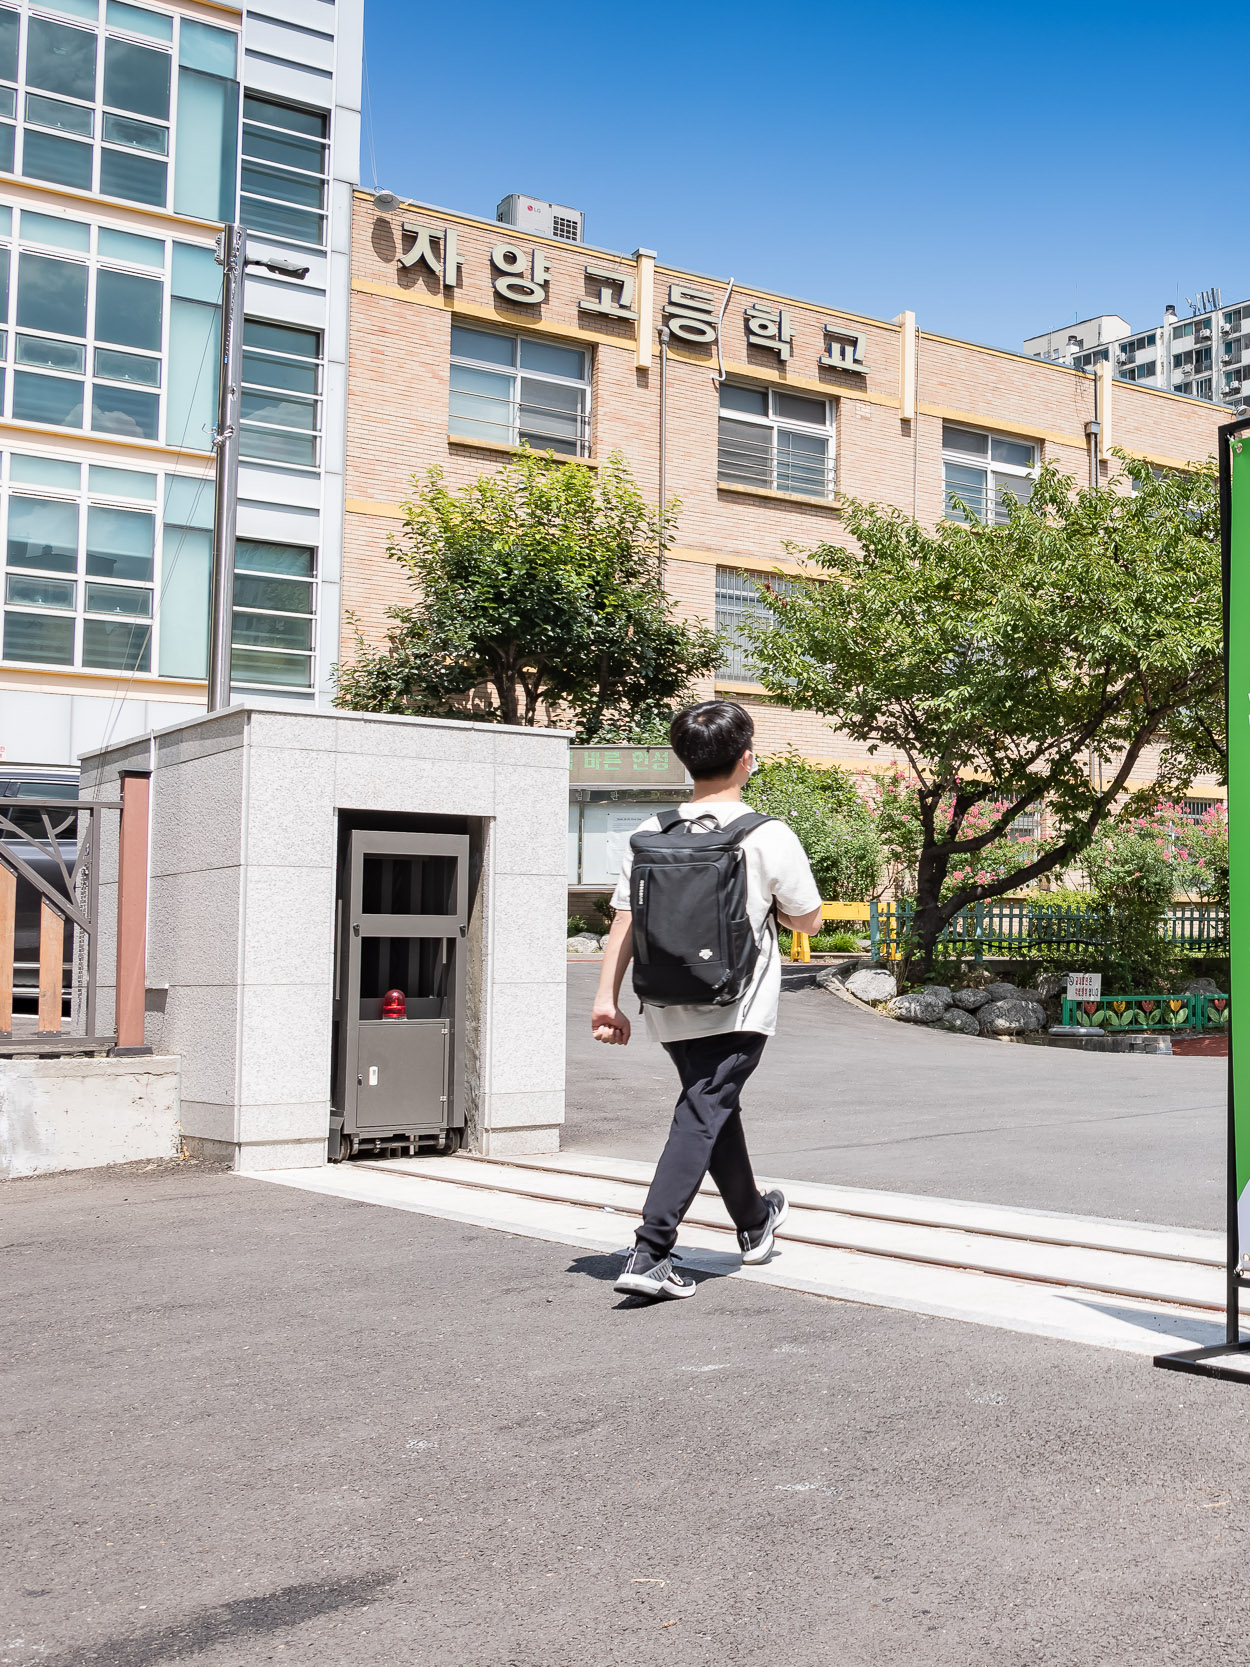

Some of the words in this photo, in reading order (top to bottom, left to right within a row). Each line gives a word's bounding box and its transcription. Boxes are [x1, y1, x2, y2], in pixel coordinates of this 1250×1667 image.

[398, 220, 870, 375] 자양고등학교
[584, 751, 622, 770] 바른
[632, 751, 669, 770] 인성
